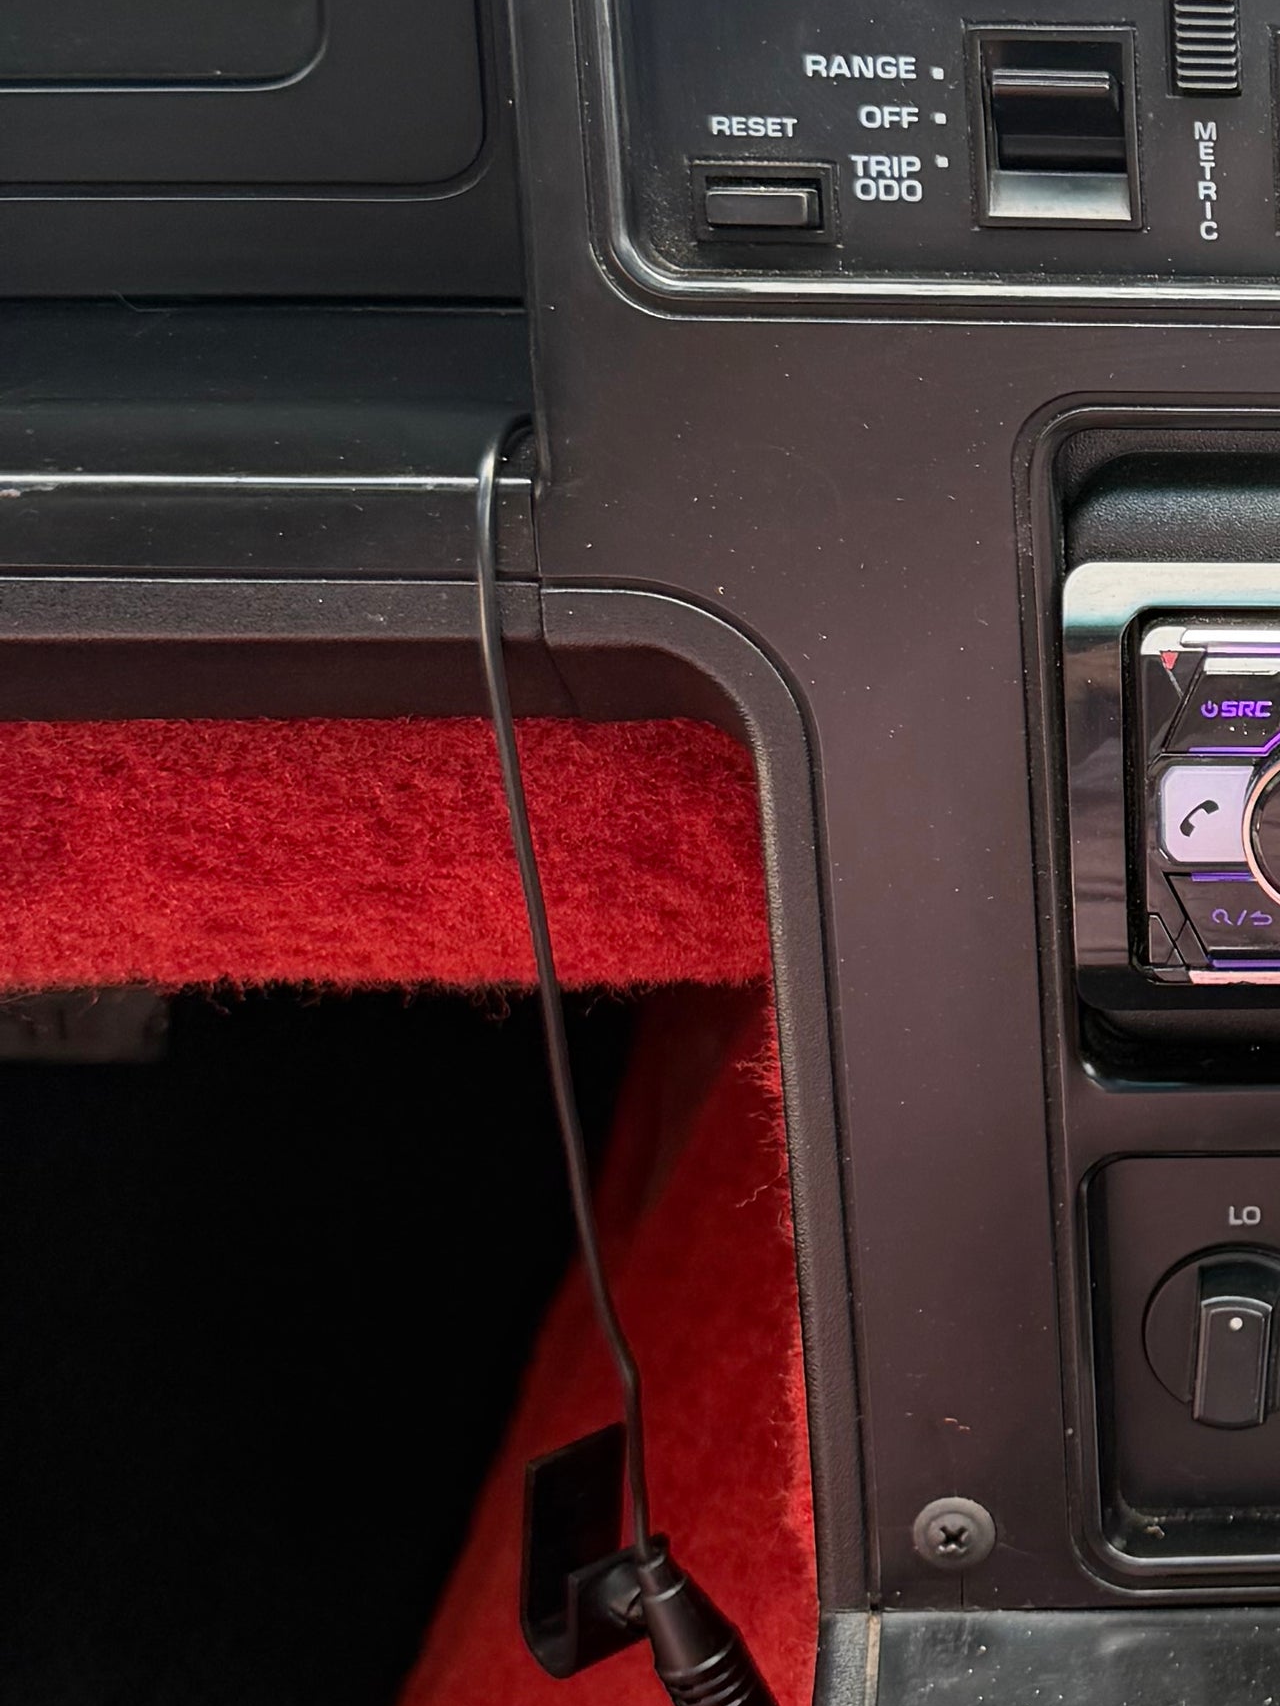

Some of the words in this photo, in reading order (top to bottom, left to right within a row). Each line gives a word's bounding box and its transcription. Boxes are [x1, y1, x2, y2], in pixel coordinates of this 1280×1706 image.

[806, 55, 916, 80] RANGE
[712, 117, 797, 137] RESET
[860, 106, 918, 129] OFF
[852, 155, 921, 179] TRIP
[855, 179, 922, 202] ODO
[1194, 121, 1219, 241] METRIC
[1221, 701, 1272, 718] SRC
[1228, 1206, 1261, 1225] LO
